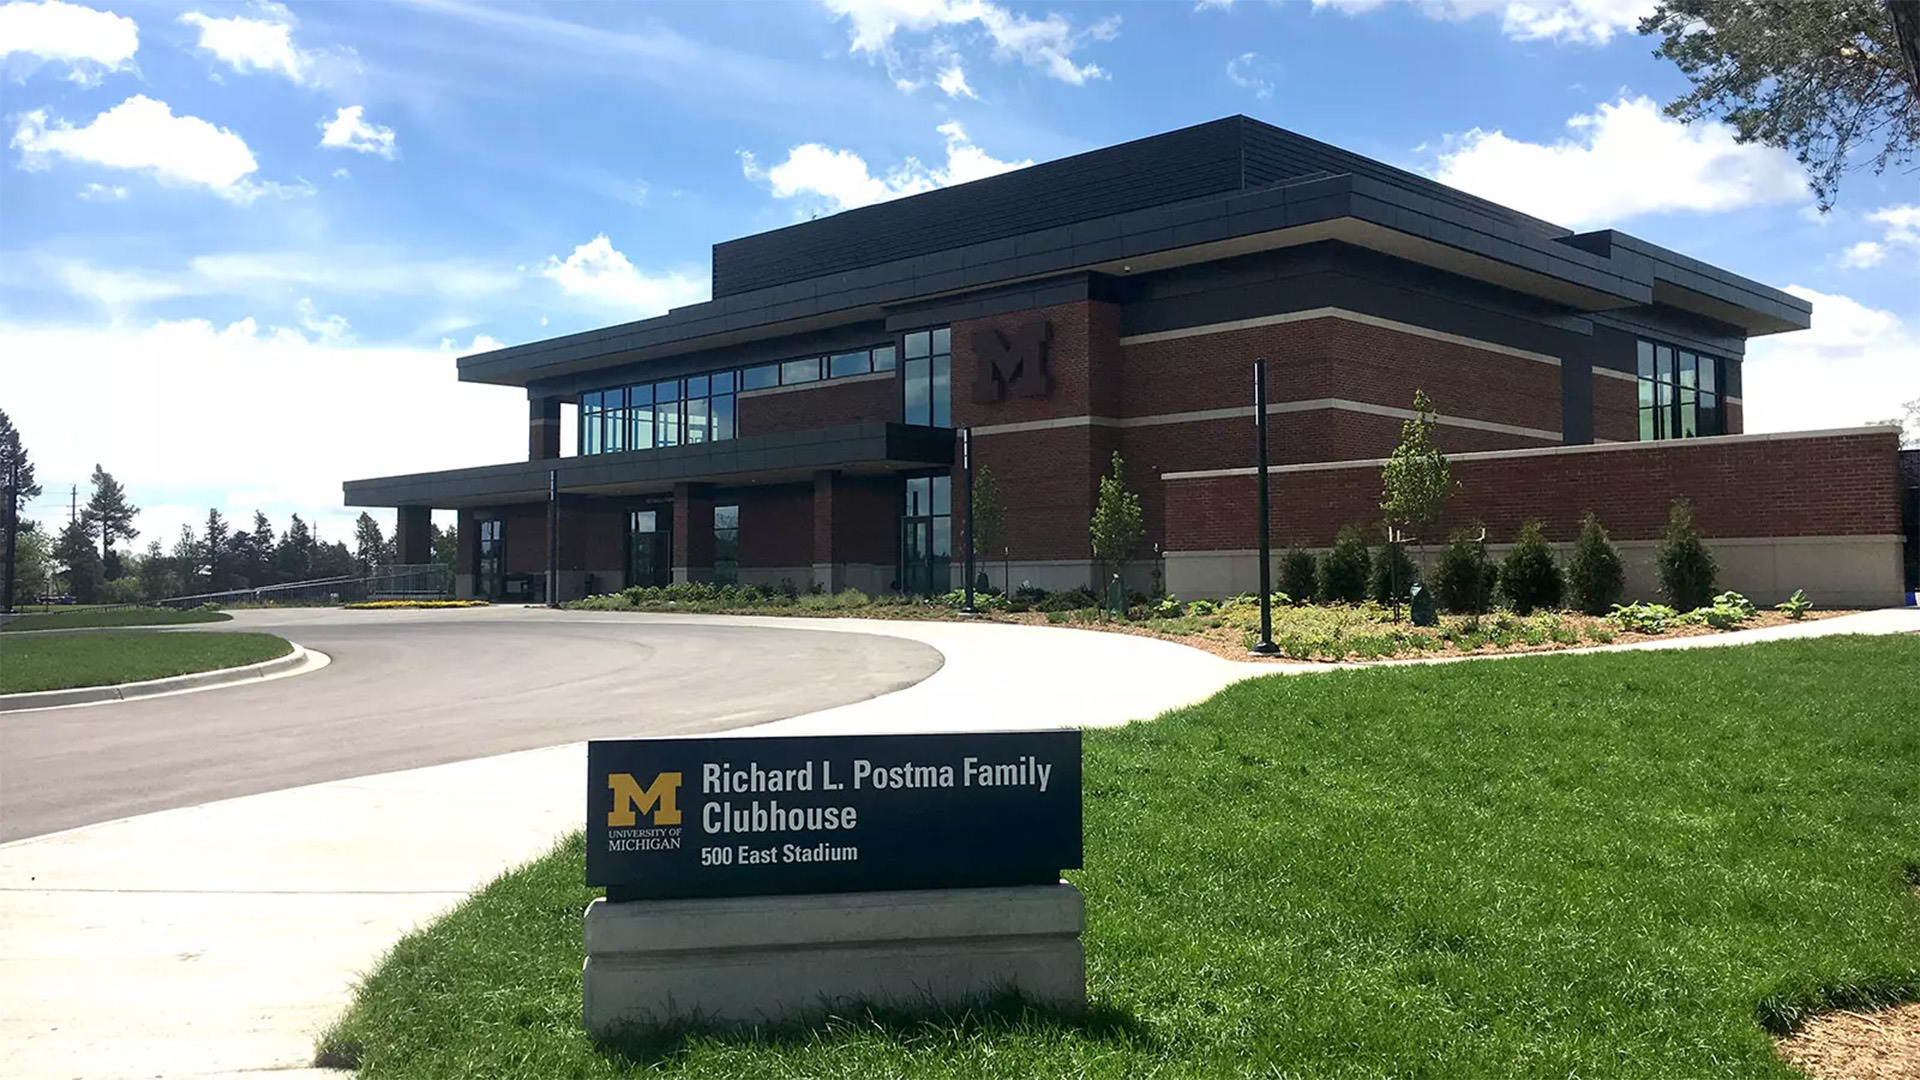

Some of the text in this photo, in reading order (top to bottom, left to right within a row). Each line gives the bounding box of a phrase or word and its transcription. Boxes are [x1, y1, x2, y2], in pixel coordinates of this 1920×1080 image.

[972, 321, 1050, 403] M
[702, 755, 1052, 794] Richard L. Postma Family
[607, 772, 682, 827] M
[608, 827, 682, 839] UNIVERSITY OF
[702, 800, 857, 834] Clubhouse
[608, 838, 681, 852] MICHIGAN
[701, 842, 858, 866] 500 East Stadium
